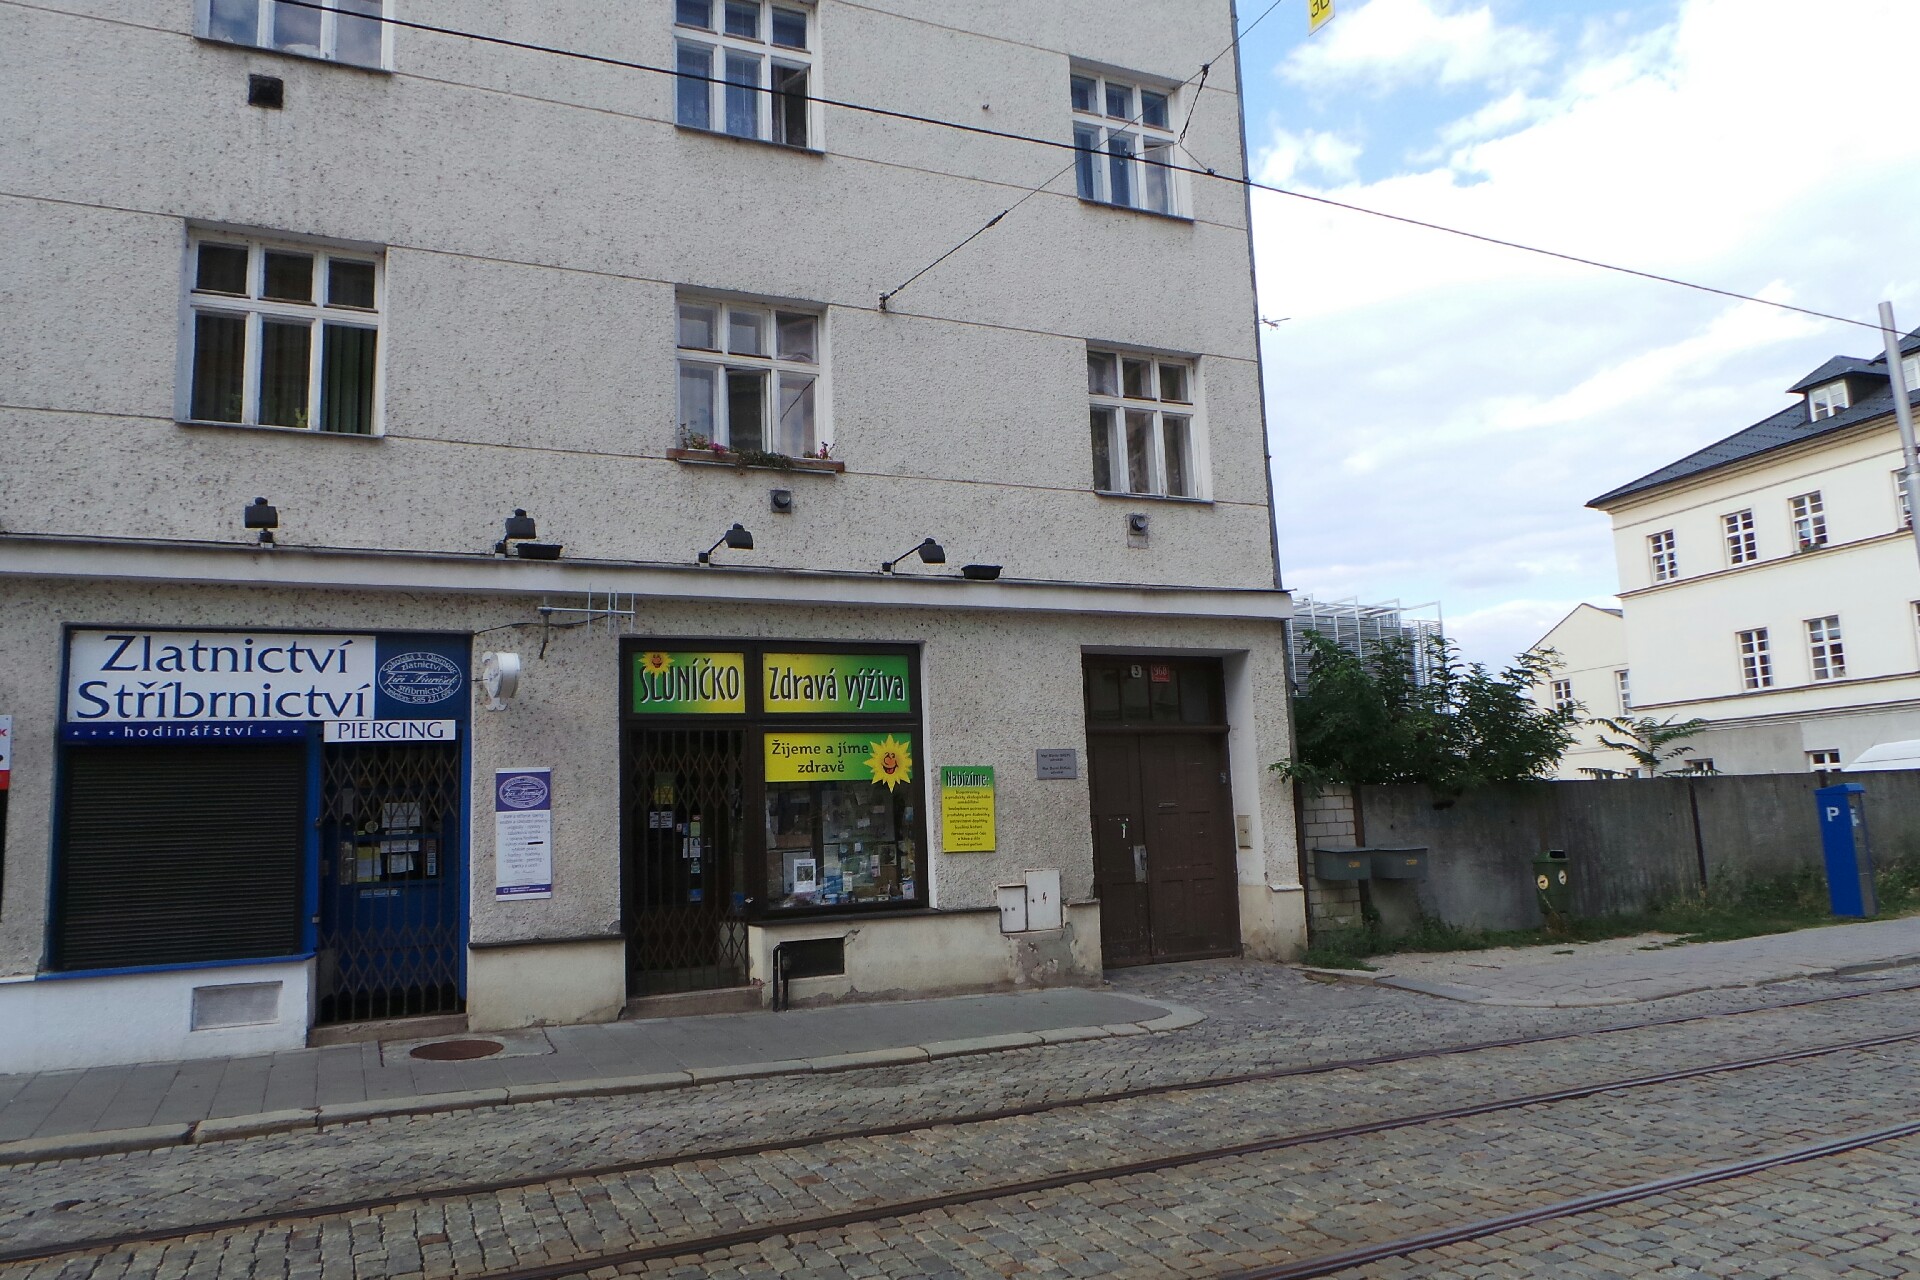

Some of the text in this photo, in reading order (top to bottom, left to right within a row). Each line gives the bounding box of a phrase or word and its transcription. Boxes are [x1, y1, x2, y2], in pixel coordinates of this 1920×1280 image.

[100, 635, 354, 674] Zlatnictví
[401, 661, 441, 671] zlatnictví
[1133, 666, 1140, 676] 3
[1153, 666, 1168, 676] 968
[639, 657, 741, 703] SLUNÍČKO
[768, 666, 906, 710] Zdravá výživa
[76, 680, 371, 719] Stříbrnictví
[124, 724, 254, 738] hodinářství
[338, 721, 444, 739] PIERCING
[771, 738, 870, 758] Žijeme a jíme
[797, 760, 846, 774] zdravě
[946, 771, 990, 787] Nabízíme:
[1826, 806, 1840, 822] P
